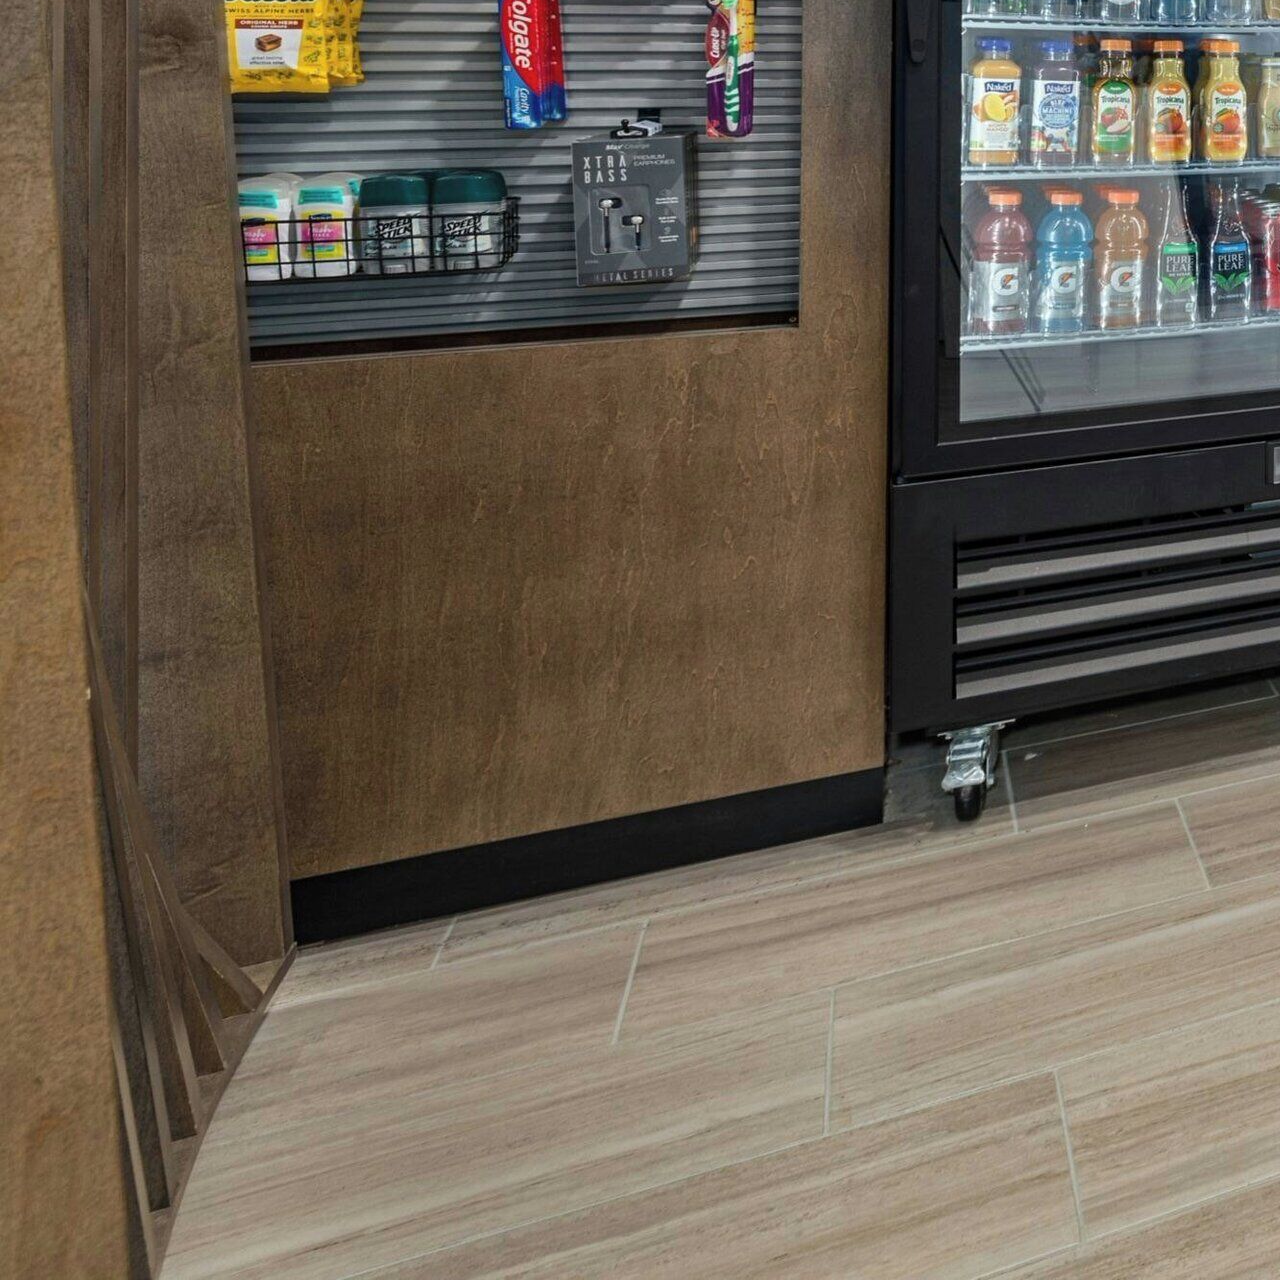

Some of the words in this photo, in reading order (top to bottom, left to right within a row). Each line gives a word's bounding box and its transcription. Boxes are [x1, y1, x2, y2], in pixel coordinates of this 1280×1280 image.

[1156, 96, 1185, 105] Tropicana
[1215, 96, 1242, 105] Tropicana
[584, 155, 627, 170] XTRA
[584, 169, 628, 184] BASS
[1166, 255, 1195, 264] PURE
[1217, 253, 1244, 263] PURE
[1166, 263, 1195, 273] LEAF
[1217, 261, 1244, 271] LEAF
